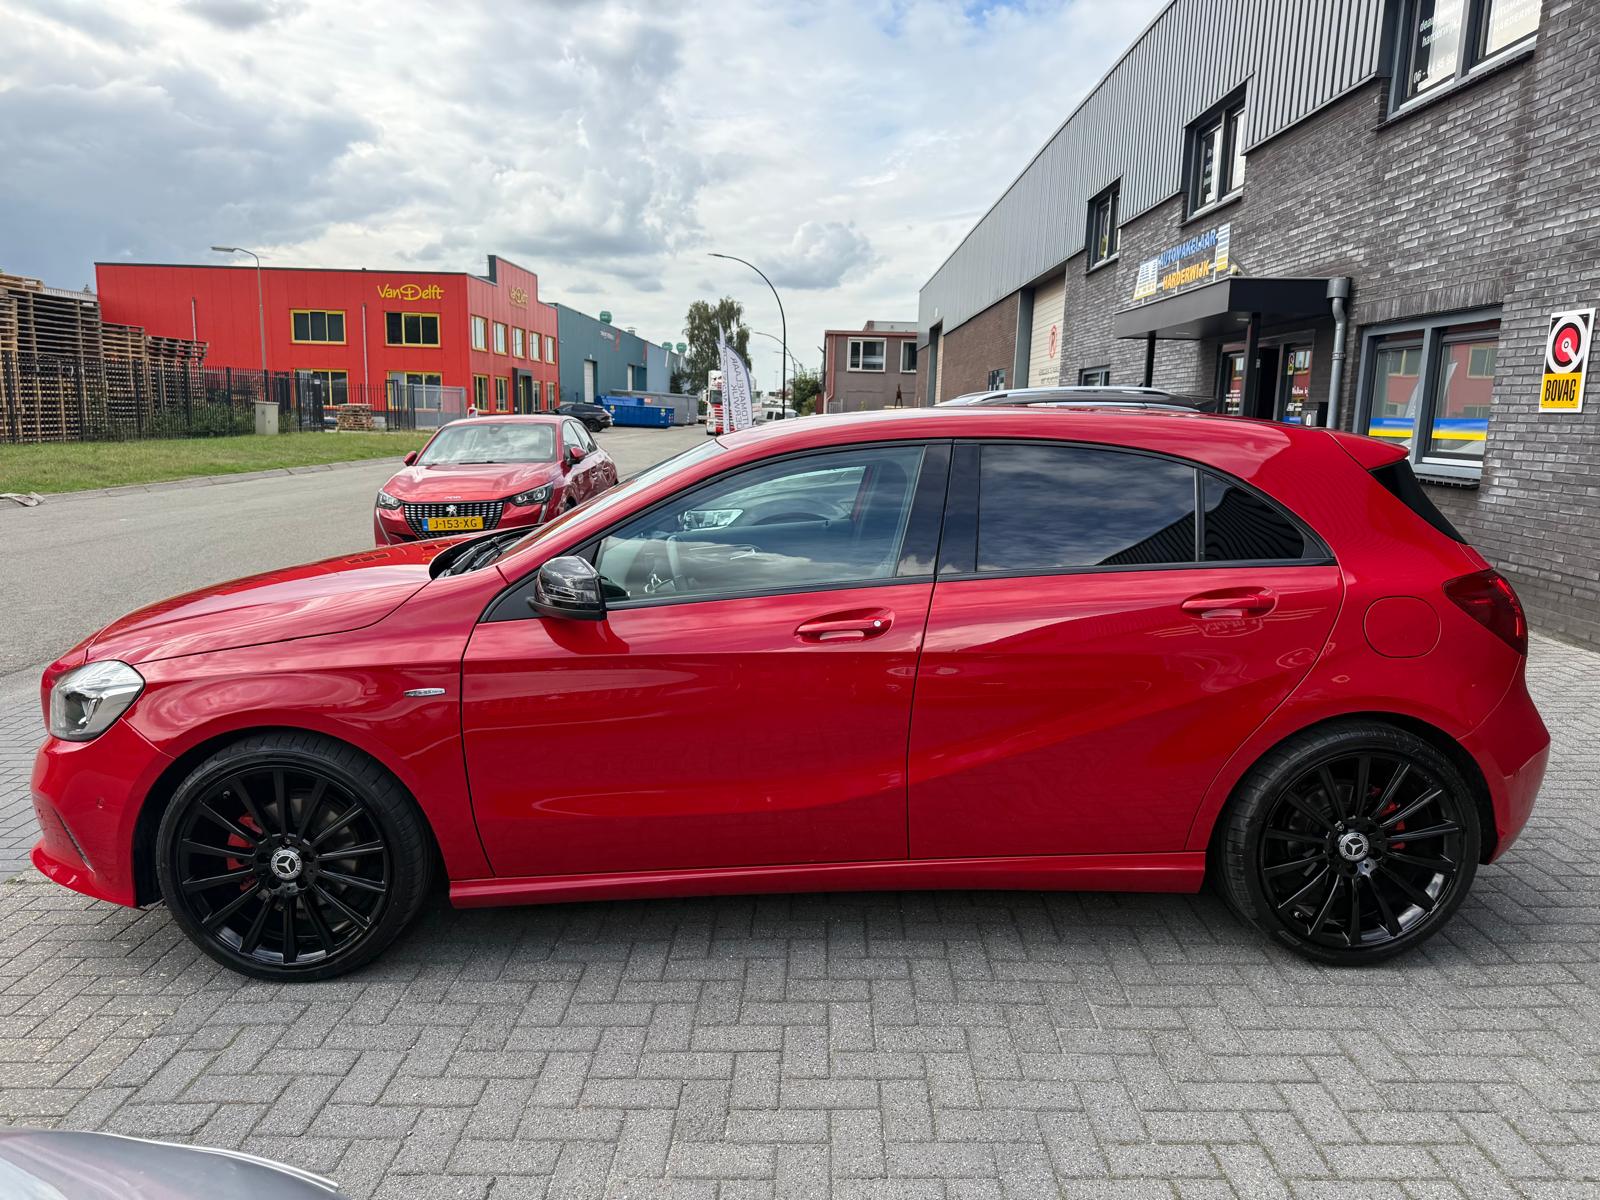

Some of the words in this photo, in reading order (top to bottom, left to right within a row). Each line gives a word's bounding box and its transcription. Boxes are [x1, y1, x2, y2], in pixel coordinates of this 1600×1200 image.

[1158, 228, 1217, 269] AUTOMAKELAAR
[1162, 259, 1211, 291] HARDERWIJK
[1544, 379, 1577, 402] BOVAG
[433, 518, 478, 529] J-153-XG
